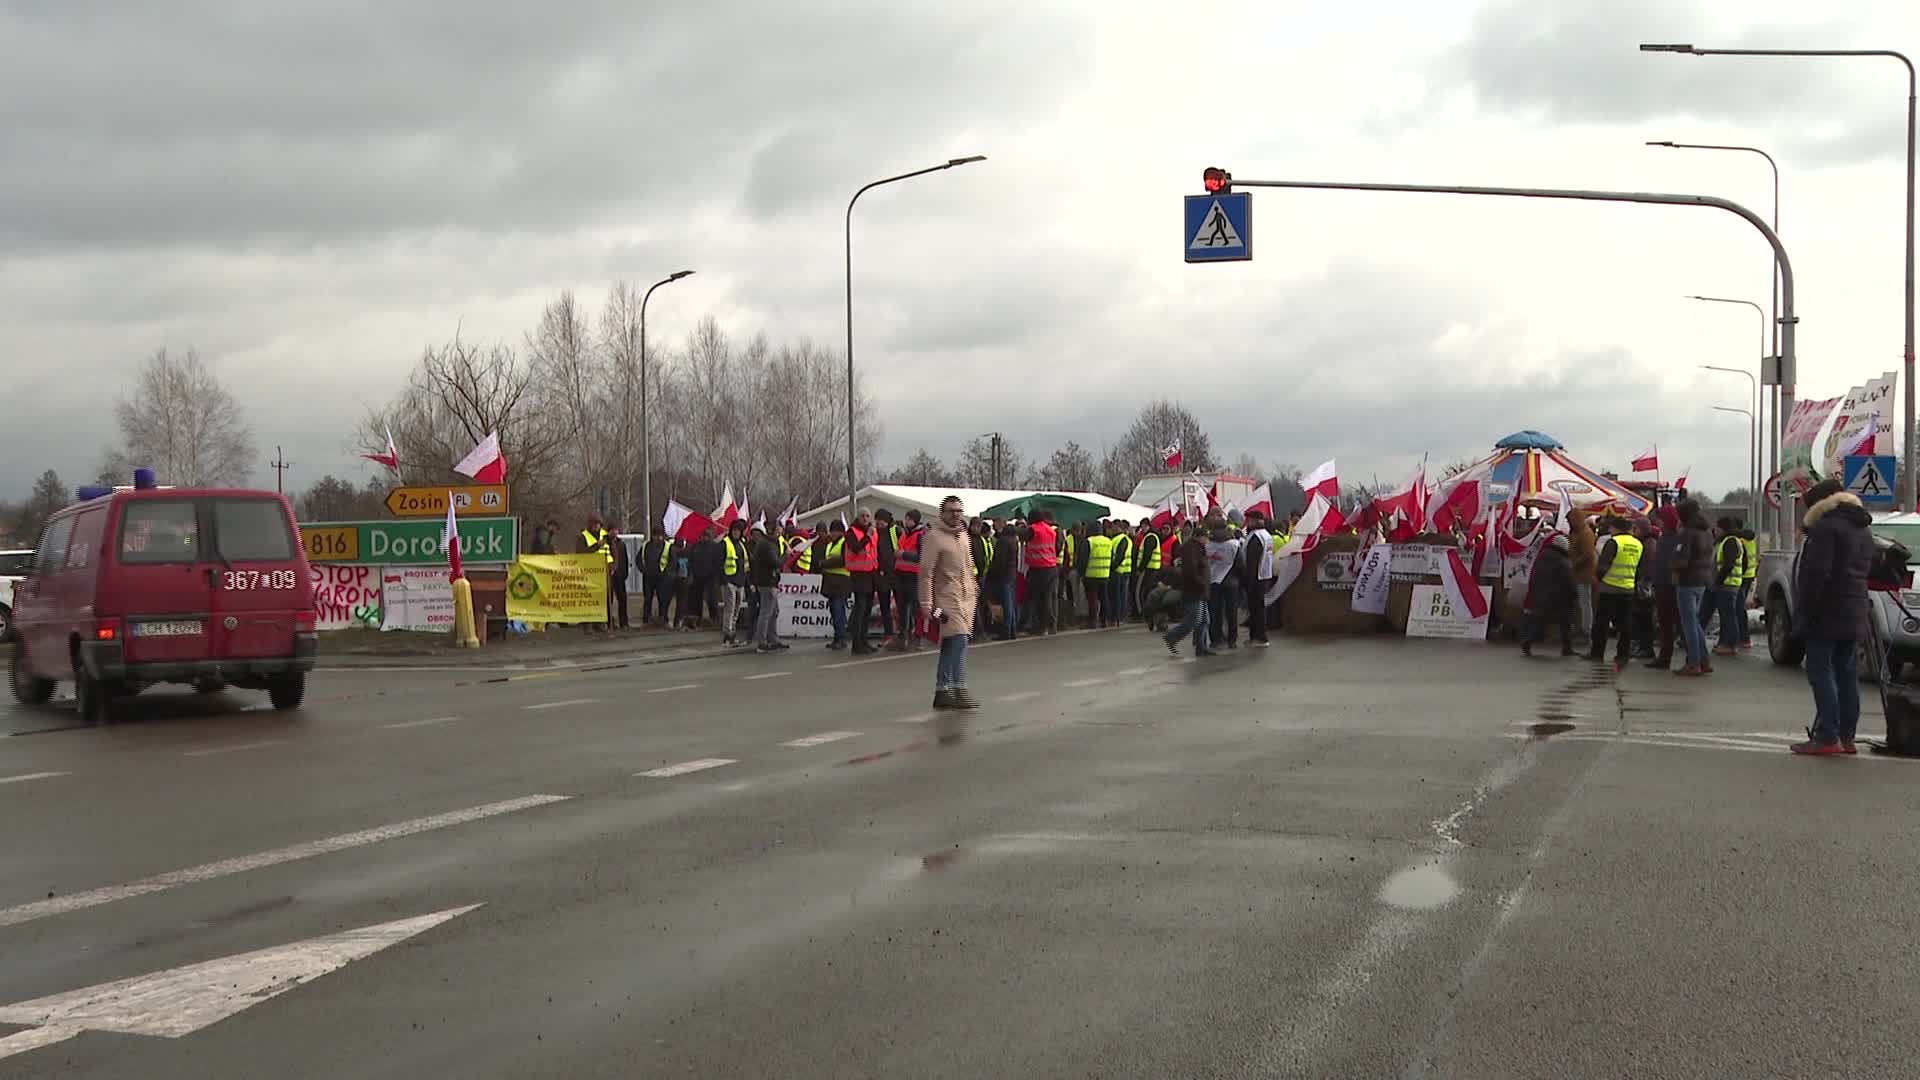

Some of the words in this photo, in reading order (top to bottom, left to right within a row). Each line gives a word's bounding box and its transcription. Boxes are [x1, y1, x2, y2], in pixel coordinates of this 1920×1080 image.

[399, 493, 443, 510] Zosin
[456, 494, 467, 506] PL
[483, 493, 498, 505] UA
[311, 531, 346, 554] 816
[224, 569, 260, 590] 367
[271, 569, 296, 590] 09
[310, 564, 369, 586] STOP
[776, 584, 808, 594] STOP
[427, 615, 455, 623] OBRON
